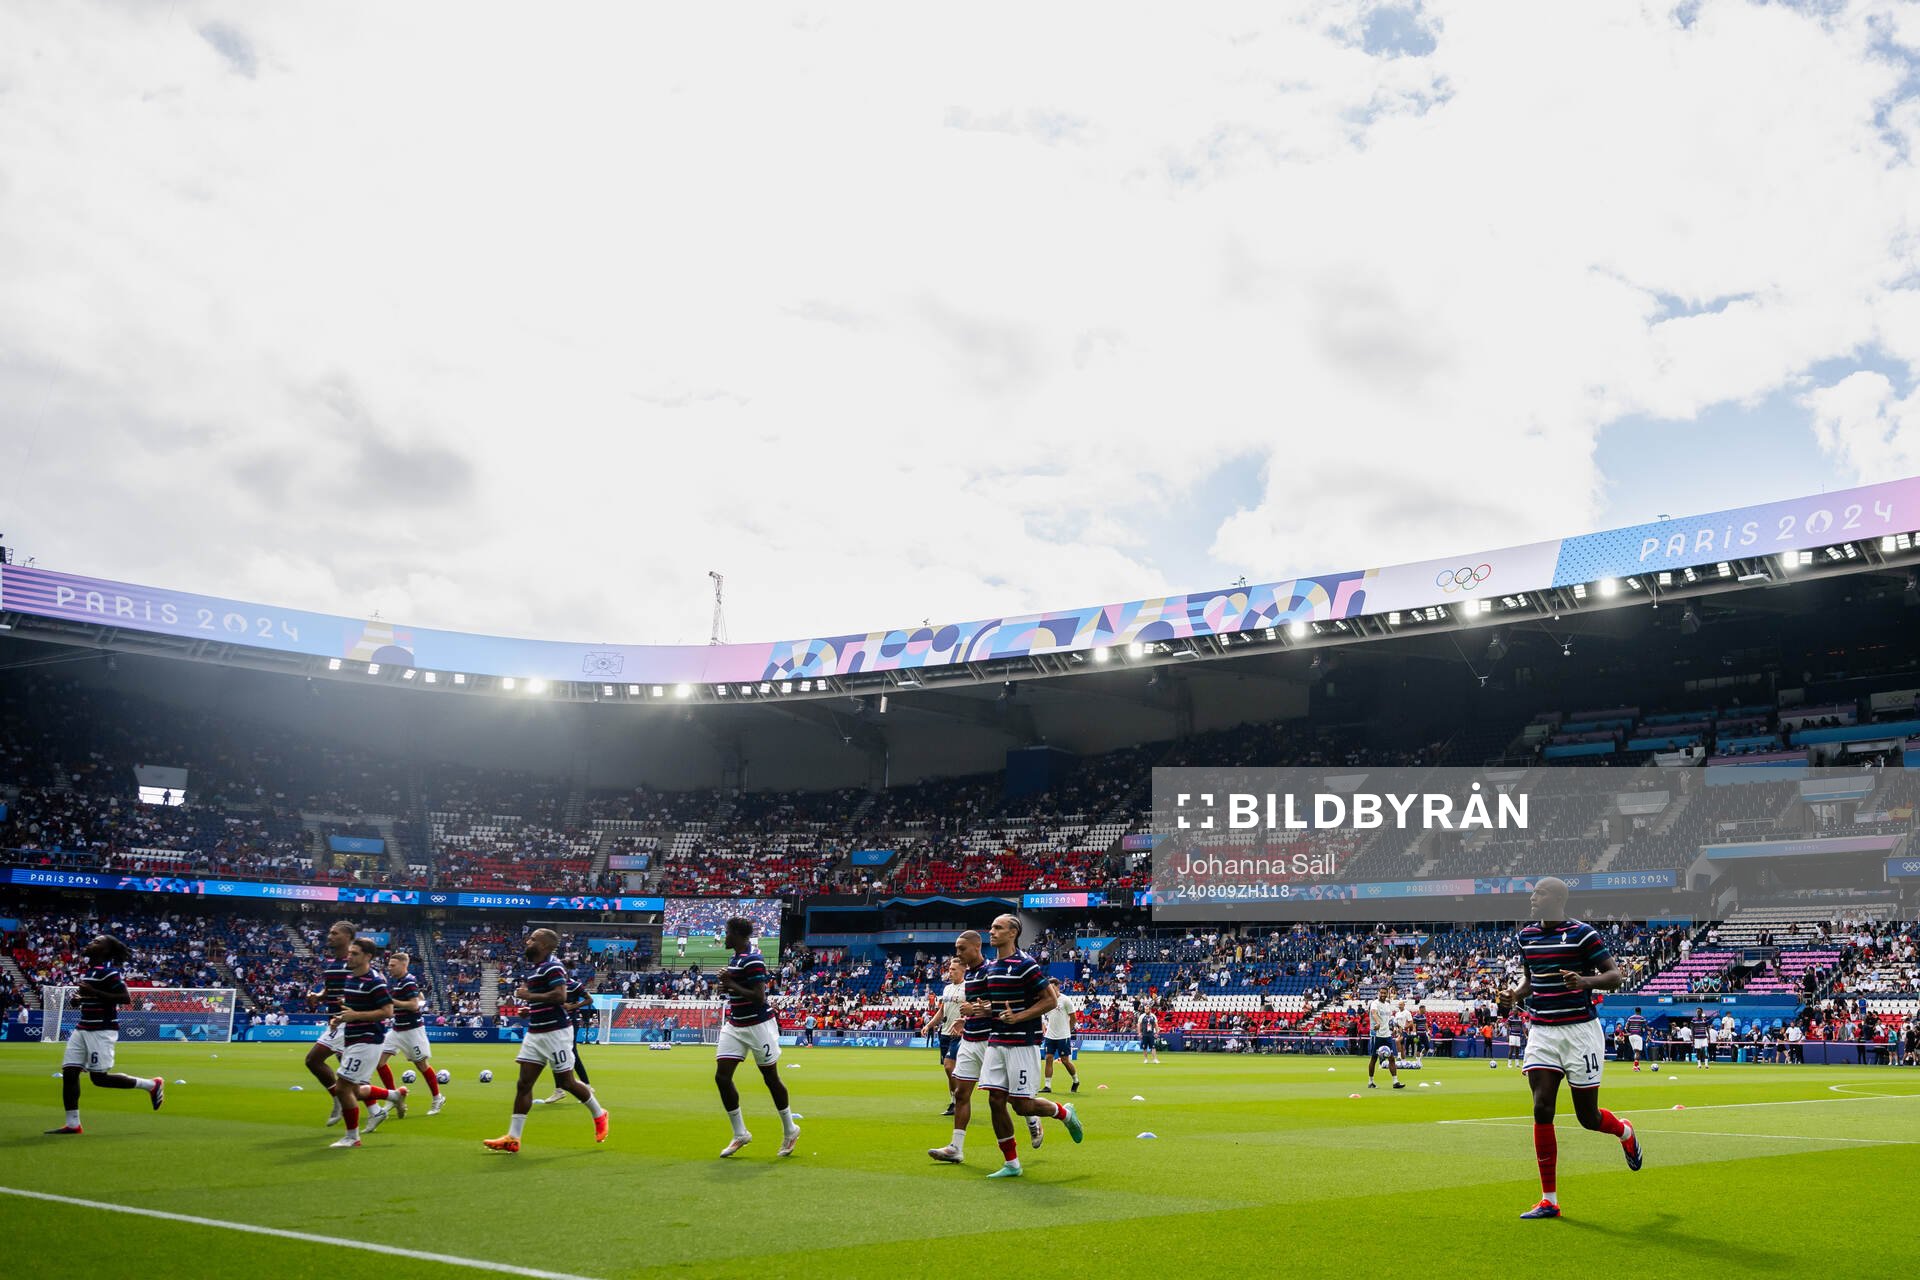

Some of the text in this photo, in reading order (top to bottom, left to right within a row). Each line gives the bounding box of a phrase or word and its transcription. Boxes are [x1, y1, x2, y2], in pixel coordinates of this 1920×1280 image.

[1775, 500, 1893, 541] 2024
[196, 608, 300, 642] 2024
[68, 875, 99, 885] 2024
[1640, 873, 1669, 884] 2024
[505, 898, 531, 906] 2024
[91, 1051, 99, 1065] 6
[413, 1046, 421, 1056] 3
[553, 1050, 568, 1066] 10
[763, 1043, 772, 1058] 2
[345, 1058, 361, 1073] 13
[1582, 1052, 1599, 1074] 14
[1019, 1069, 1028, 1086] 5
